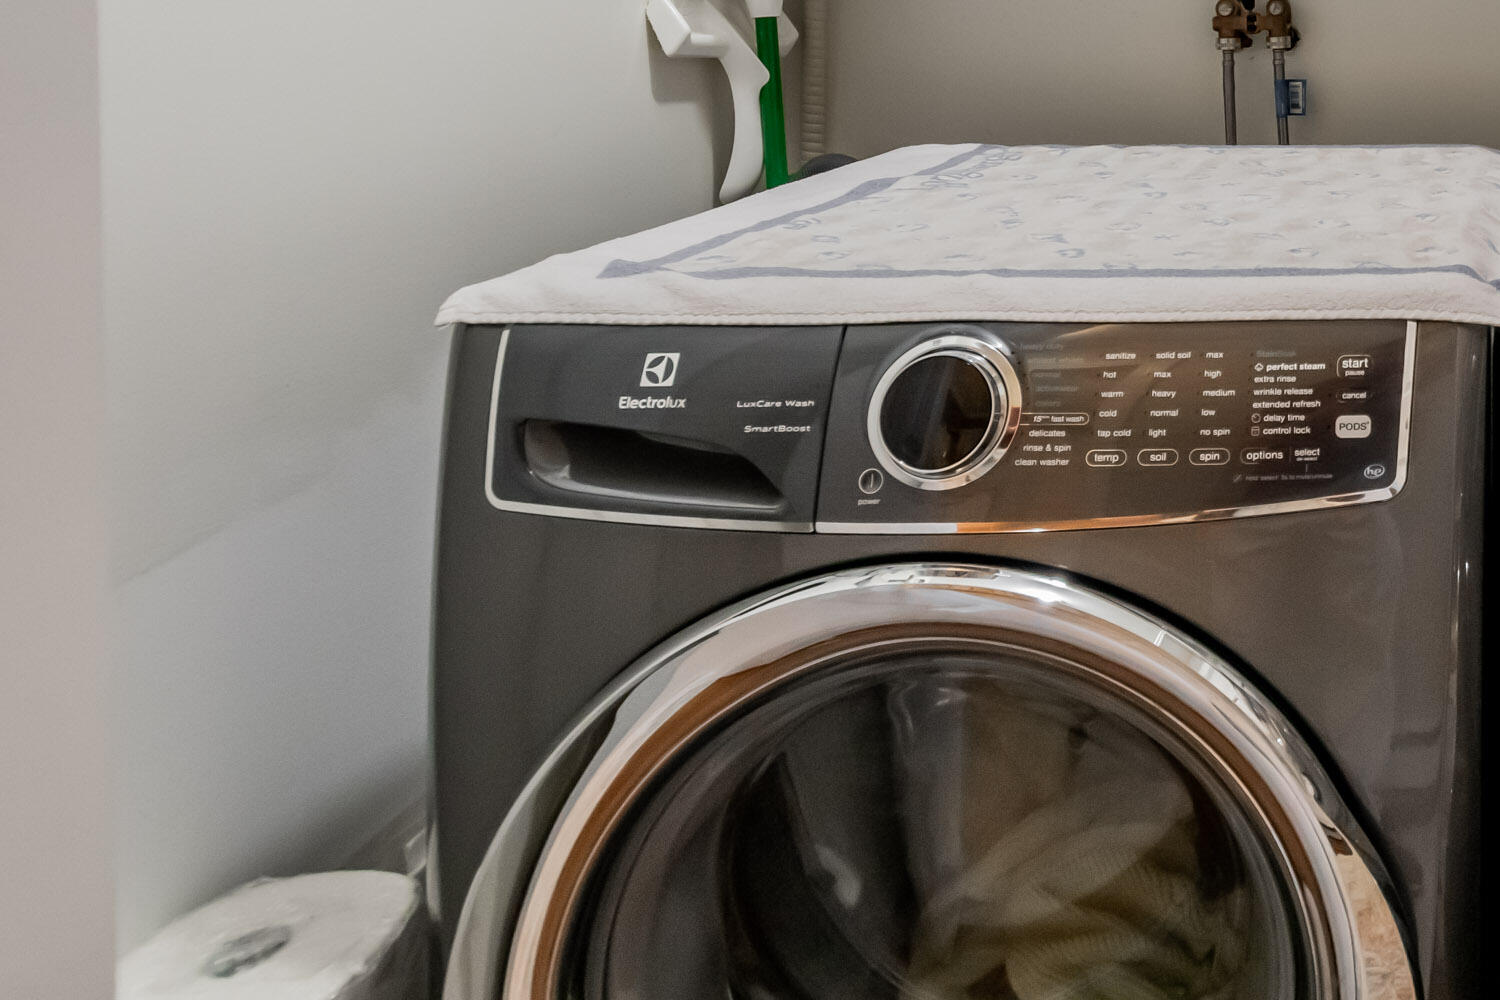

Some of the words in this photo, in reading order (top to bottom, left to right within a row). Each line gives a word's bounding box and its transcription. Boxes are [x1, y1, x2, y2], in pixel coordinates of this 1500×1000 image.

[1105, 352, 1136, 360] sanitize
[1156, 351, 1175, 359] solid
[1177, 351, 1191, 359] soil
[1266, 363, 1297, 372] perfect
[1342, 358, 1369, 368] start
[1204, 370, 1222, 380] high
[1152, 390, 1176, 399] heavy
[618, 395, 687, 409] Electrolux
[736, 400, 781, 408] LuxCare
[1252, 400, 1290, 408] extended
[1292, 400, 1321, 408] refresh
[1099, 409, 1117, 417] cold
[1150, 409, 1178, 417] normal
[1263, 414, 1285, 423] delay
[1339, 422, 1367, 431] PODS
[1098, 430, 1111, 438] tap
[1113, 429, 1131, 437] cold
[1149, 428, 1166, 438] light
[1213, 428, 1231, 437] spin
[1054, 444, 1071, 453] spin
[1094, 453, 1120, 464] temp
[1150, 453, 1167, 462] soil
[1199, 453, 1220, 463] spin
[1246, 451, 1283, 461] options
[1294, 448, 1320, 456] select
